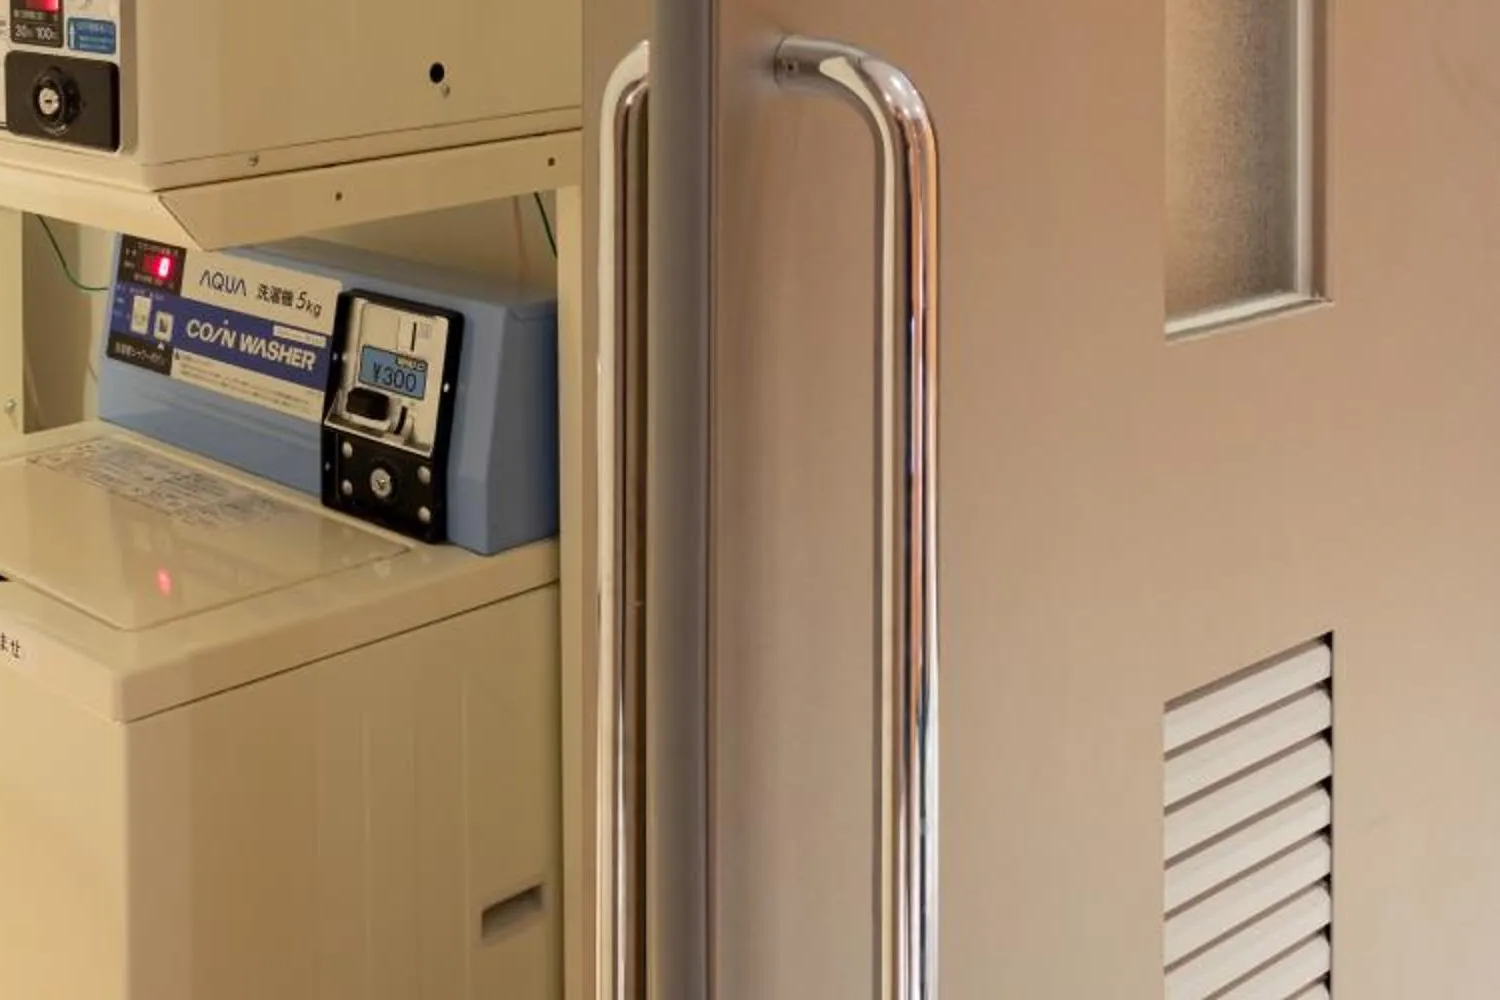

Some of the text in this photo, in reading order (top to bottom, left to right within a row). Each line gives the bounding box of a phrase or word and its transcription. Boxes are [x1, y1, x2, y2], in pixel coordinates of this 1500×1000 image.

[199, 269, 248, 297] AQUA
[294, 290, 323, 319] 5kg
[239, 335, 317, 373] WASHER
[370, 361, 418, 394] ¥300
